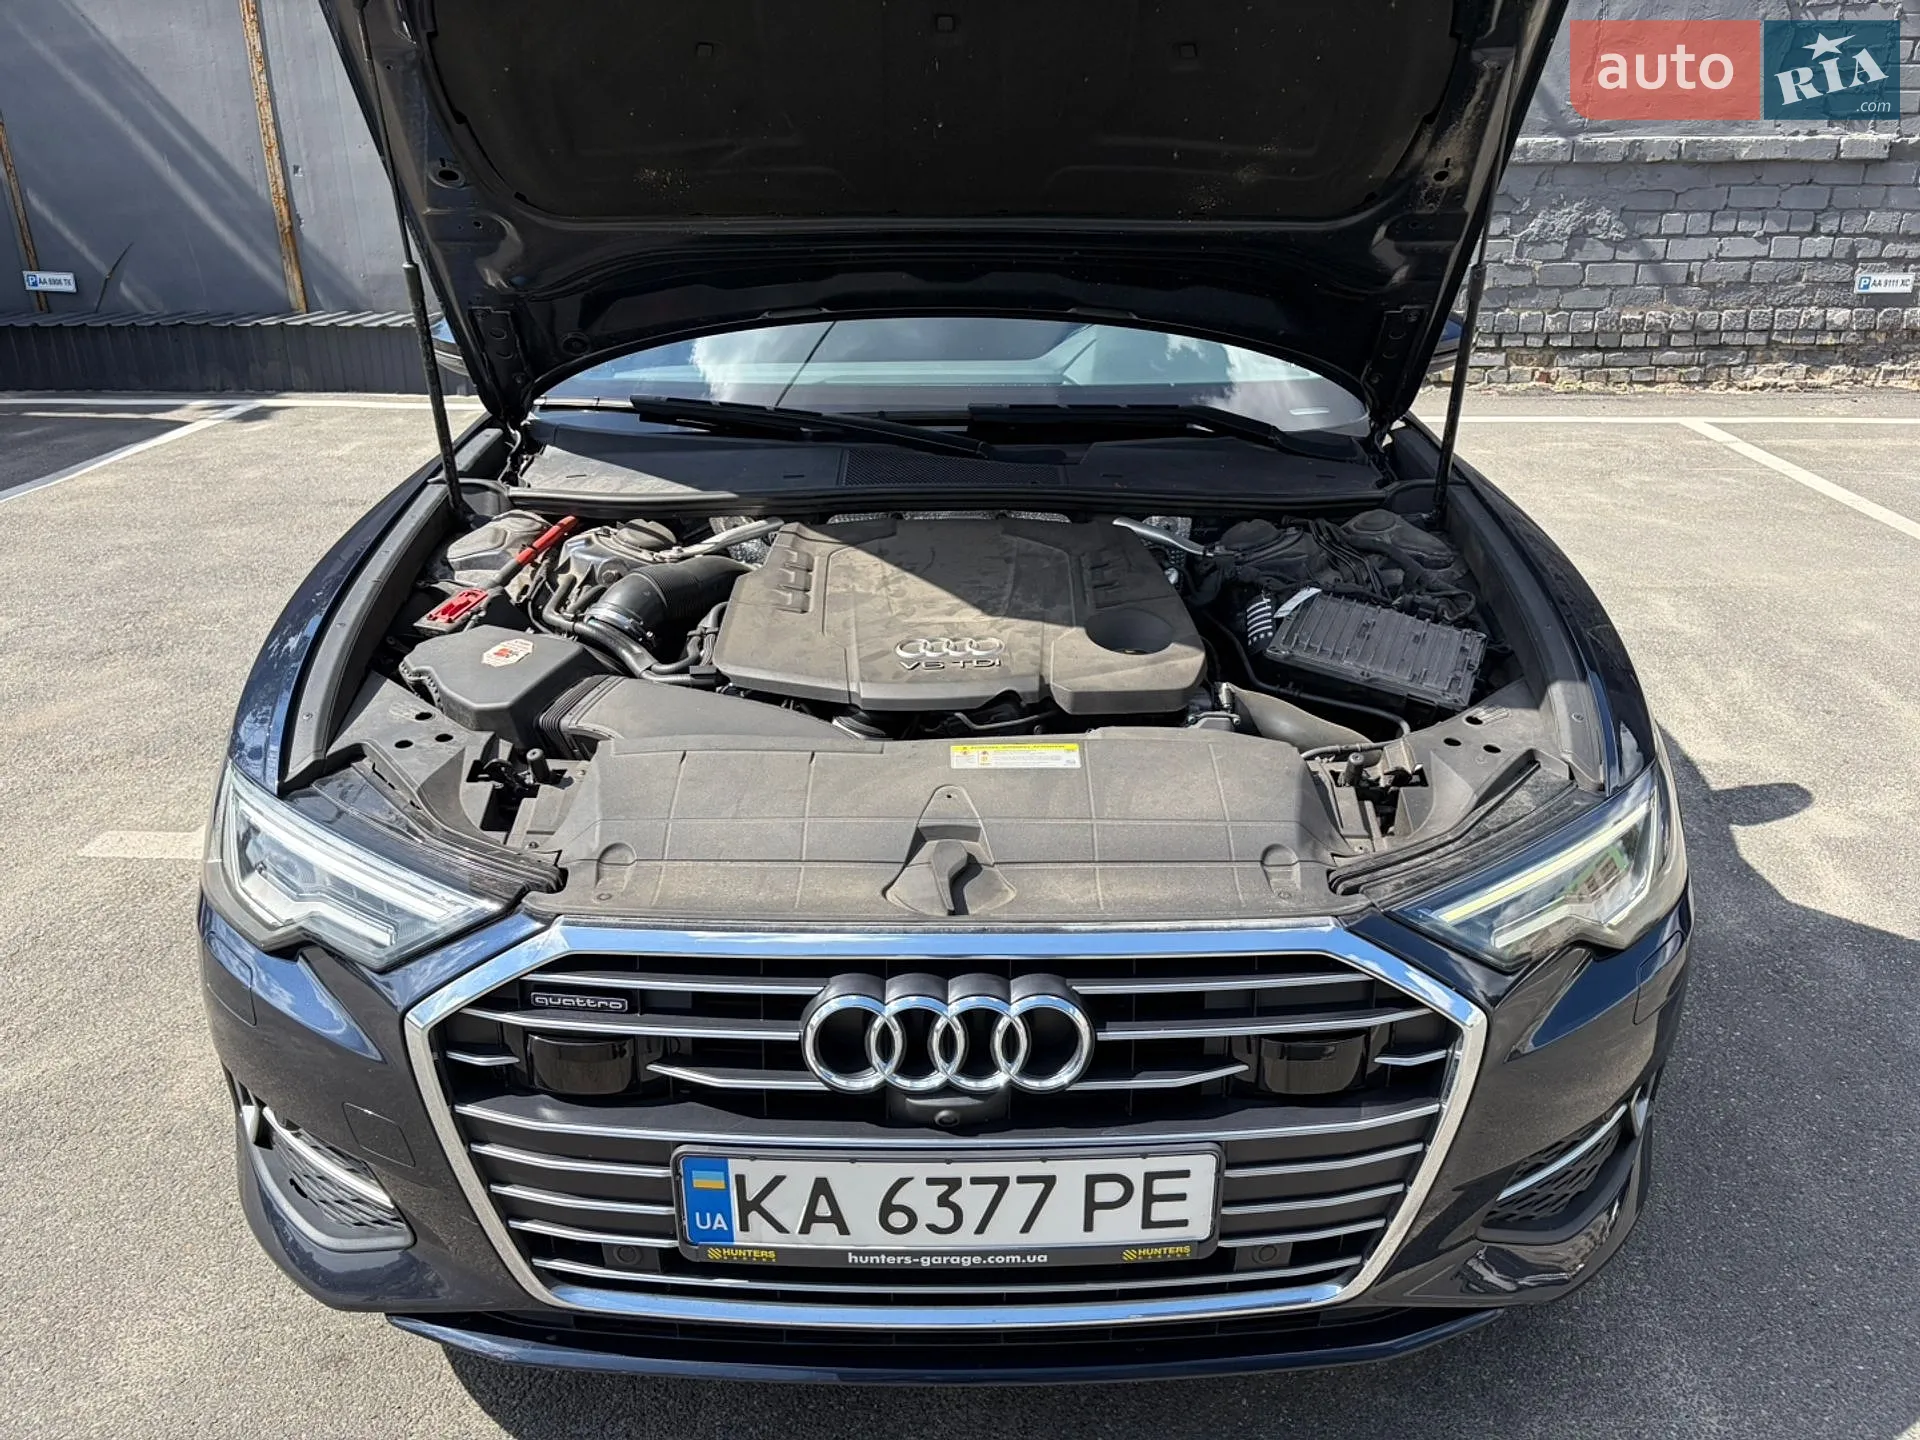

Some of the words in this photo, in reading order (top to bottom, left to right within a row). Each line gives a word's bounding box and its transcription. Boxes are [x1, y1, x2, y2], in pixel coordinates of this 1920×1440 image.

[39, 278, 48, 286] AA
[1871, 279, 1882, 288] AA
[951, 658, 1002, 669] TDI
[534, 996, 623, 1009] quattro
[734, 1174, 851, 1235] KA
[878, 1174, 1058, 1235] 6377
[1083, 1169, 1191, 1232] PE
[695, 1212, 728, 1231] UA
[722, 1248, 777, 1259] HUNTERS
[1138, 1245, 1191, 1256] HUNTERS
[847, 1252, 1048, 1266] hunters-garage.com.ua
